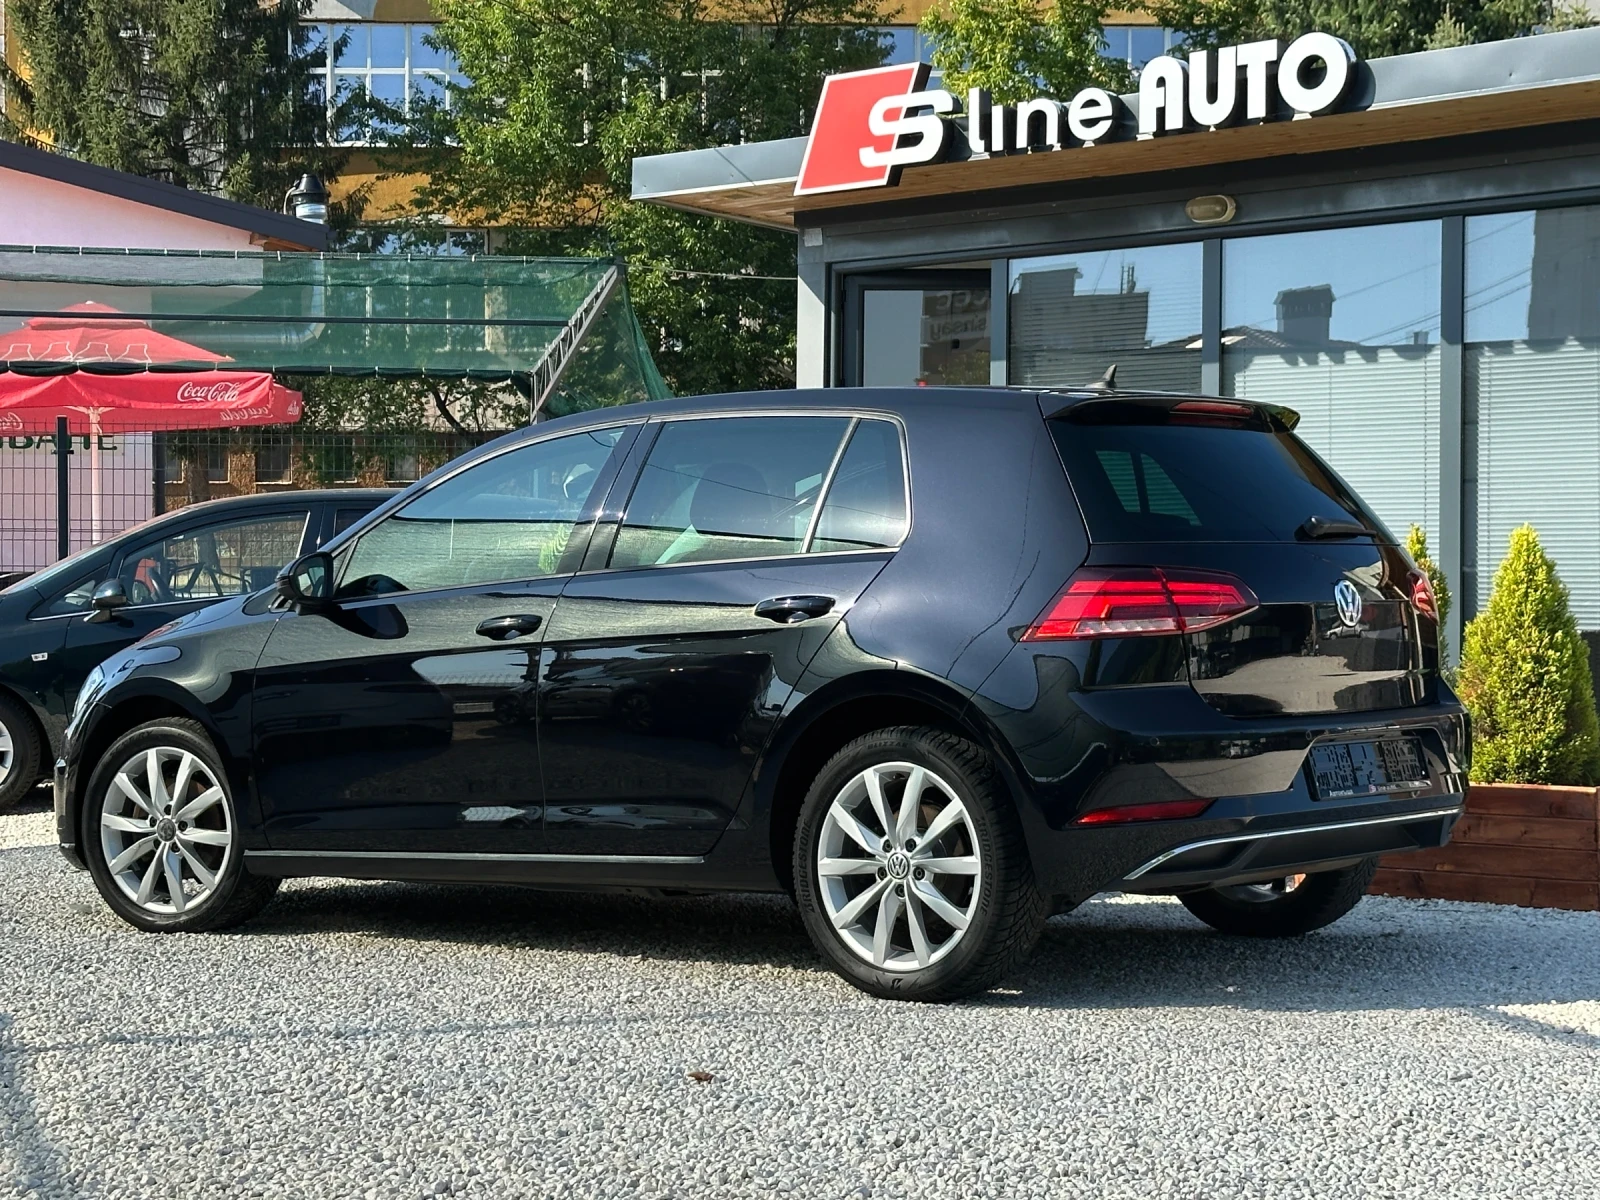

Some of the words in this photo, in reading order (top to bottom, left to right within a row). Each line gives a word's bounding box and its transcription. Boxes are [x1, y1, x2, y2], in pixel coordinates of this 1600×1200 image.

[968, 87, 1113, 153] line
[1139, 31, 1347, 133] AUTO
[177, 381, 241, 402] Coca-Cola
[800, 818, 816, 914] BRIDGESTONE
